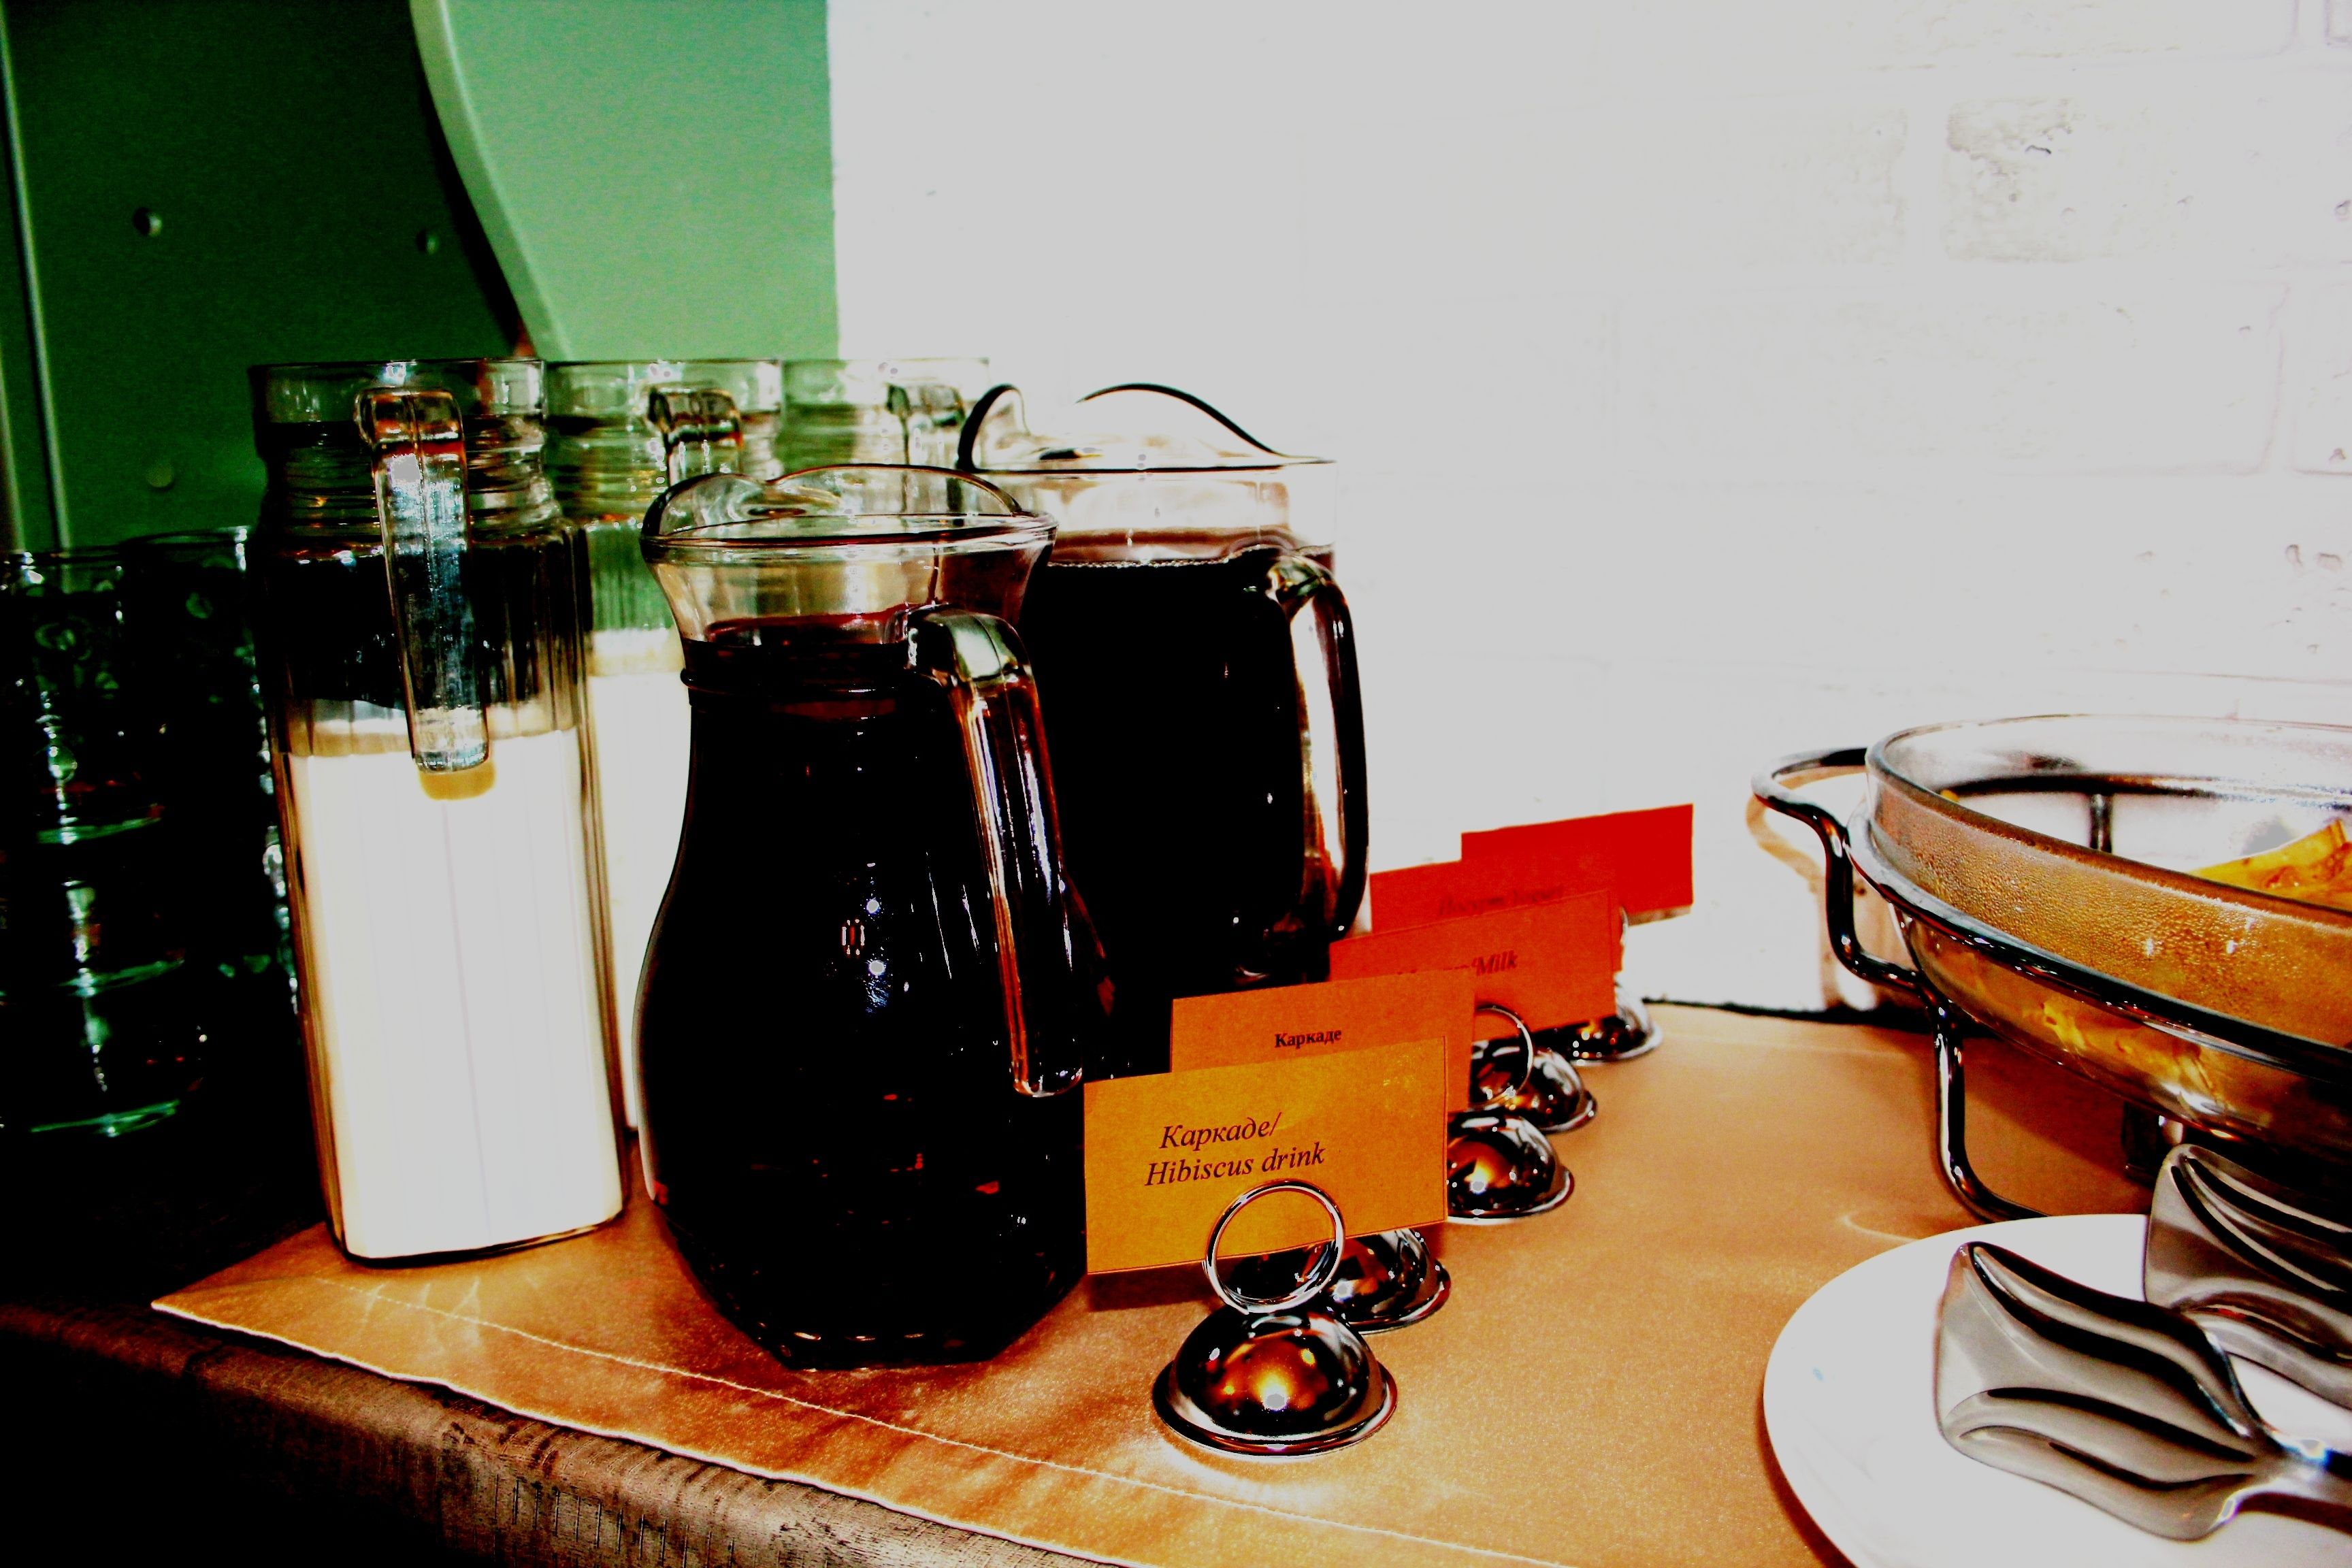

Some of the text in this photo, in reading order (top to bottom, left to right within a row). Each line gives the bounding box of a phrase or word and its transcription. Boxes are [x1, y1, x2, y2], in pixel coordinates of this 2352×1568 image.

[1274, 1029, 1342, 1049] Каркаде
[1158, 1111, 1282, 1152] Каркаде/
[1144, 1141, 1327, 1186] Hibiscus drink
